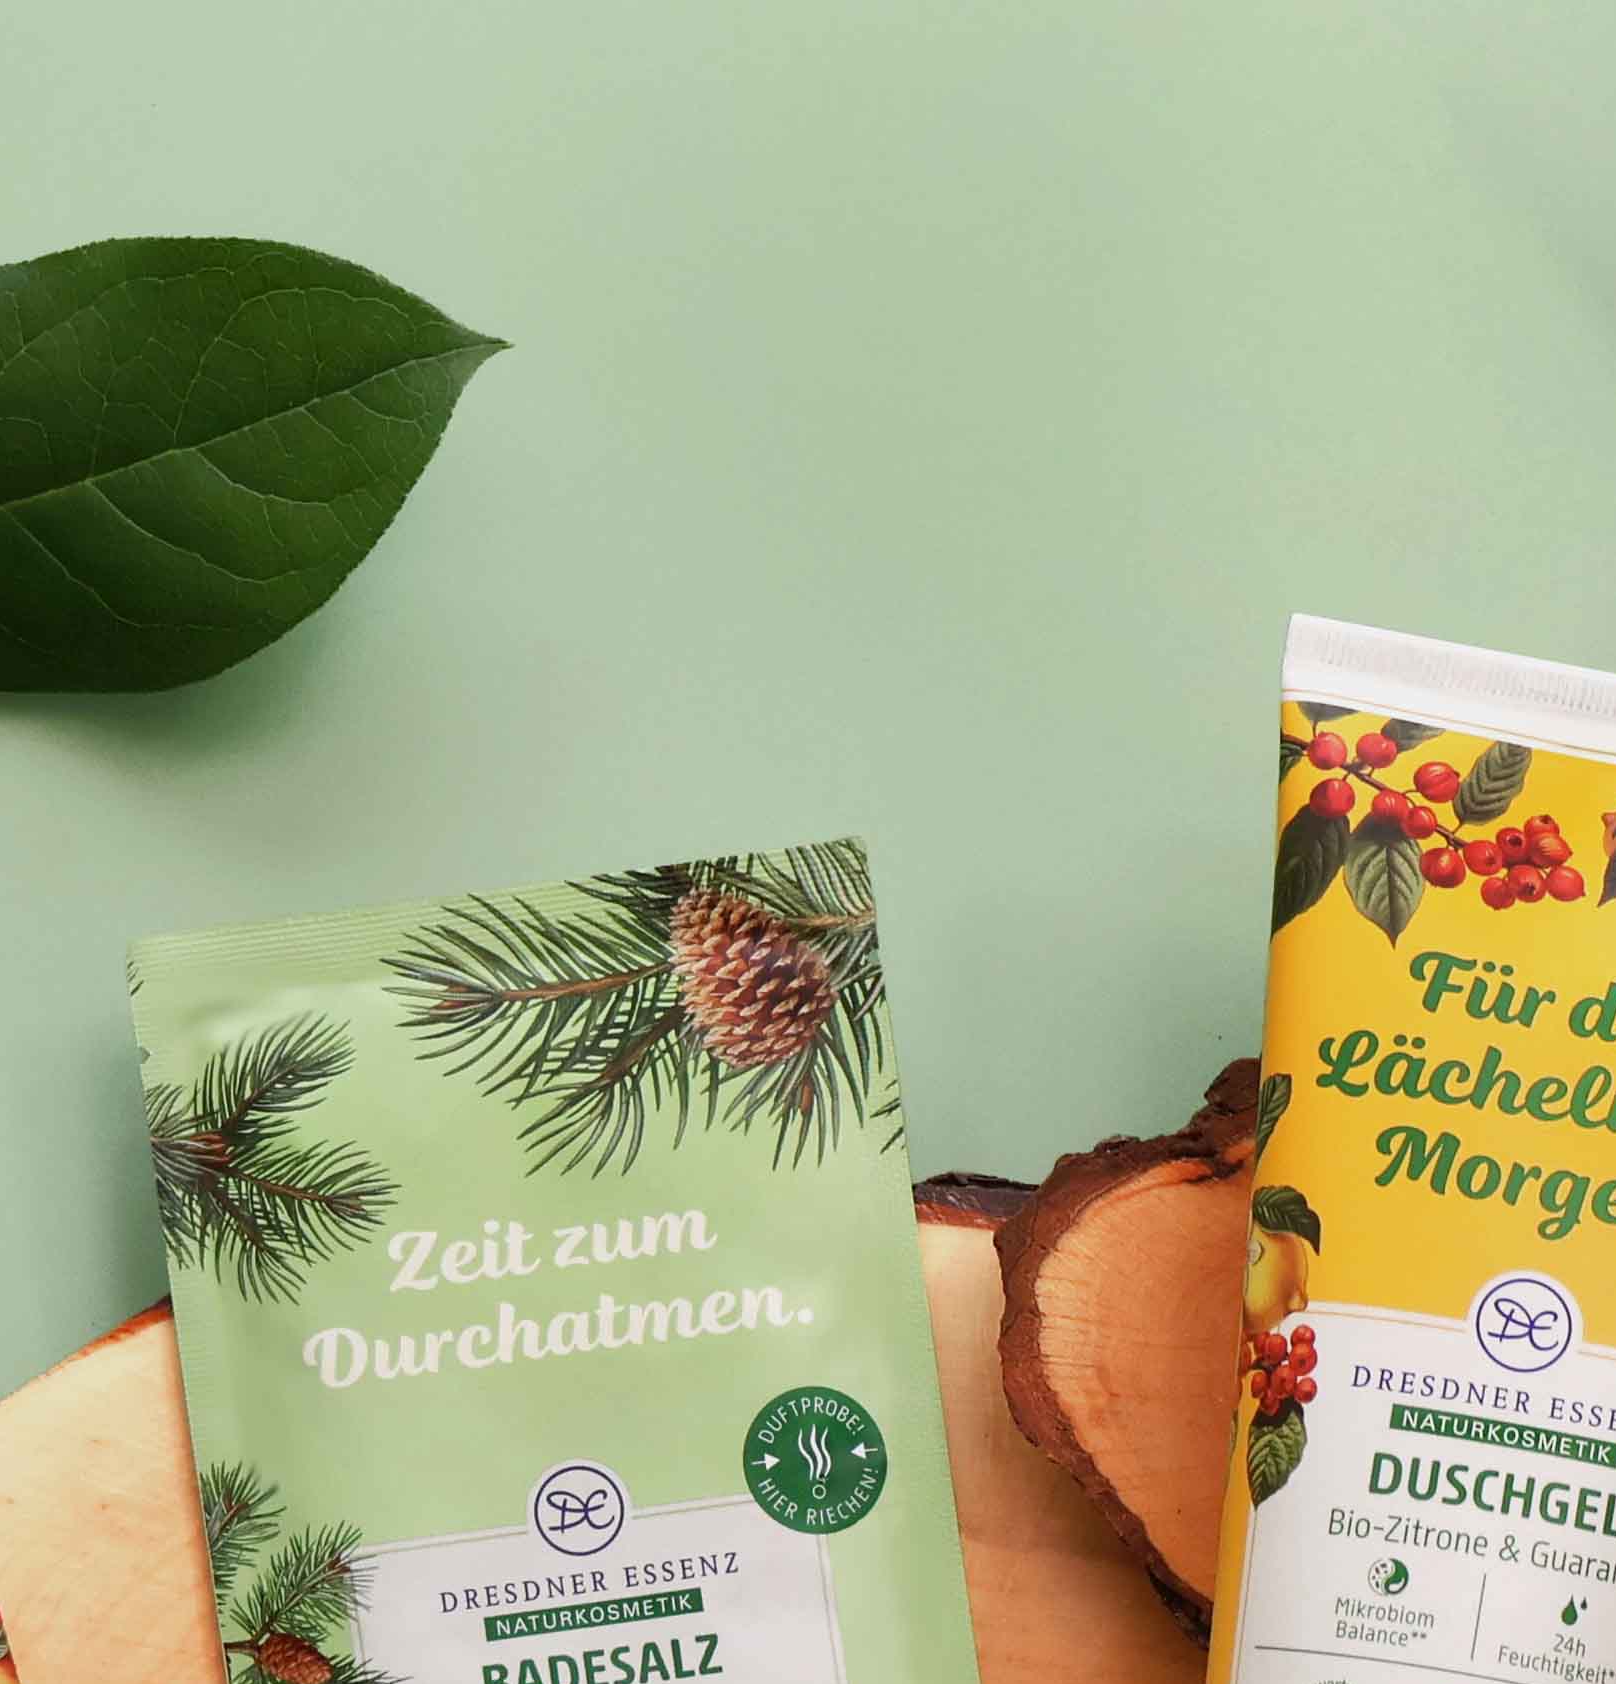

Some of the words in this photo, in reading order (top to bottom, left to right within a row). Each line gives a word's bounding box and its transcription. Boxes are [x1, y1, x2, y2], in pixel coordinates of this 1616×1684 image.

[1409, 951, 1557, 1028] Für
[387, 1219, 542, 1292] Zeit
[552, 1209, 719, 1268] zum
[302, 1285, 814, 1388] Durchatmen.
[1351, 1365, 1532, 1414] DRESDNER
[758, 1396, 865, 1444] DUFTPROBE!
[1402, 1409, 1613, 1464] NATURKOSMETIK
[758, 1478, 798, 1520] HIER
[806, 1467, 879, 1525] RIECHEN!
[1328, 1508, 1489, 1557] Bio-Zitrone
[1499, 1534, 1521, 1563] &
[440, 1570, 608, 1614] DRESDNER
[624, 1551, 739, 1588] ESSENZ
[496, 1593, 692, 1636] NATURKOSMETIK
[1334, 1597, 1435, 1629] Mikrobiom
[1553, 1633, 1587, 1657] 24h
